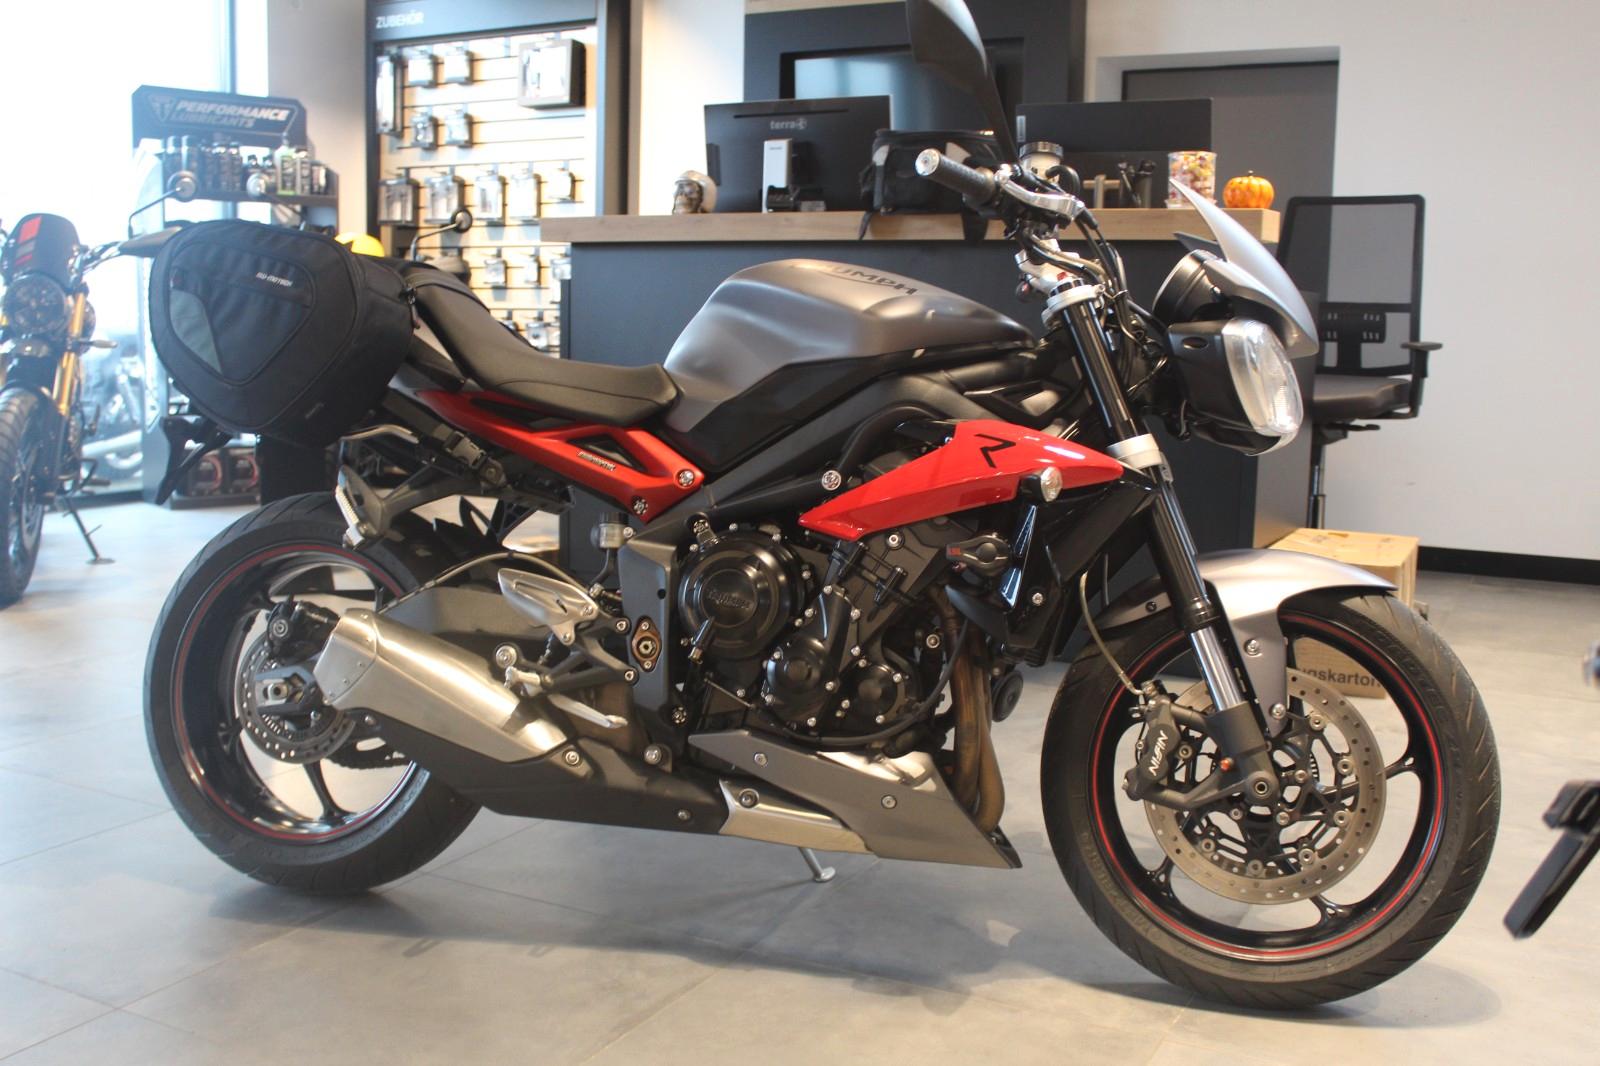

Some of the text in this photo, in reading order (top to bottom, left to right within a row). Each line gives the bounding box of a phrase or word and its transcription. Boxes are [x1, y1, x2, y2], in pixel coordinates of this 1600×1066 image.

[375, 9, 425, 29] ZUBEHÖR
[176, 99, 291, 121] PERFORMANCE
[170, 111, 256, 129] LUBRICANTS
[770, 120, 796, 129] terra
